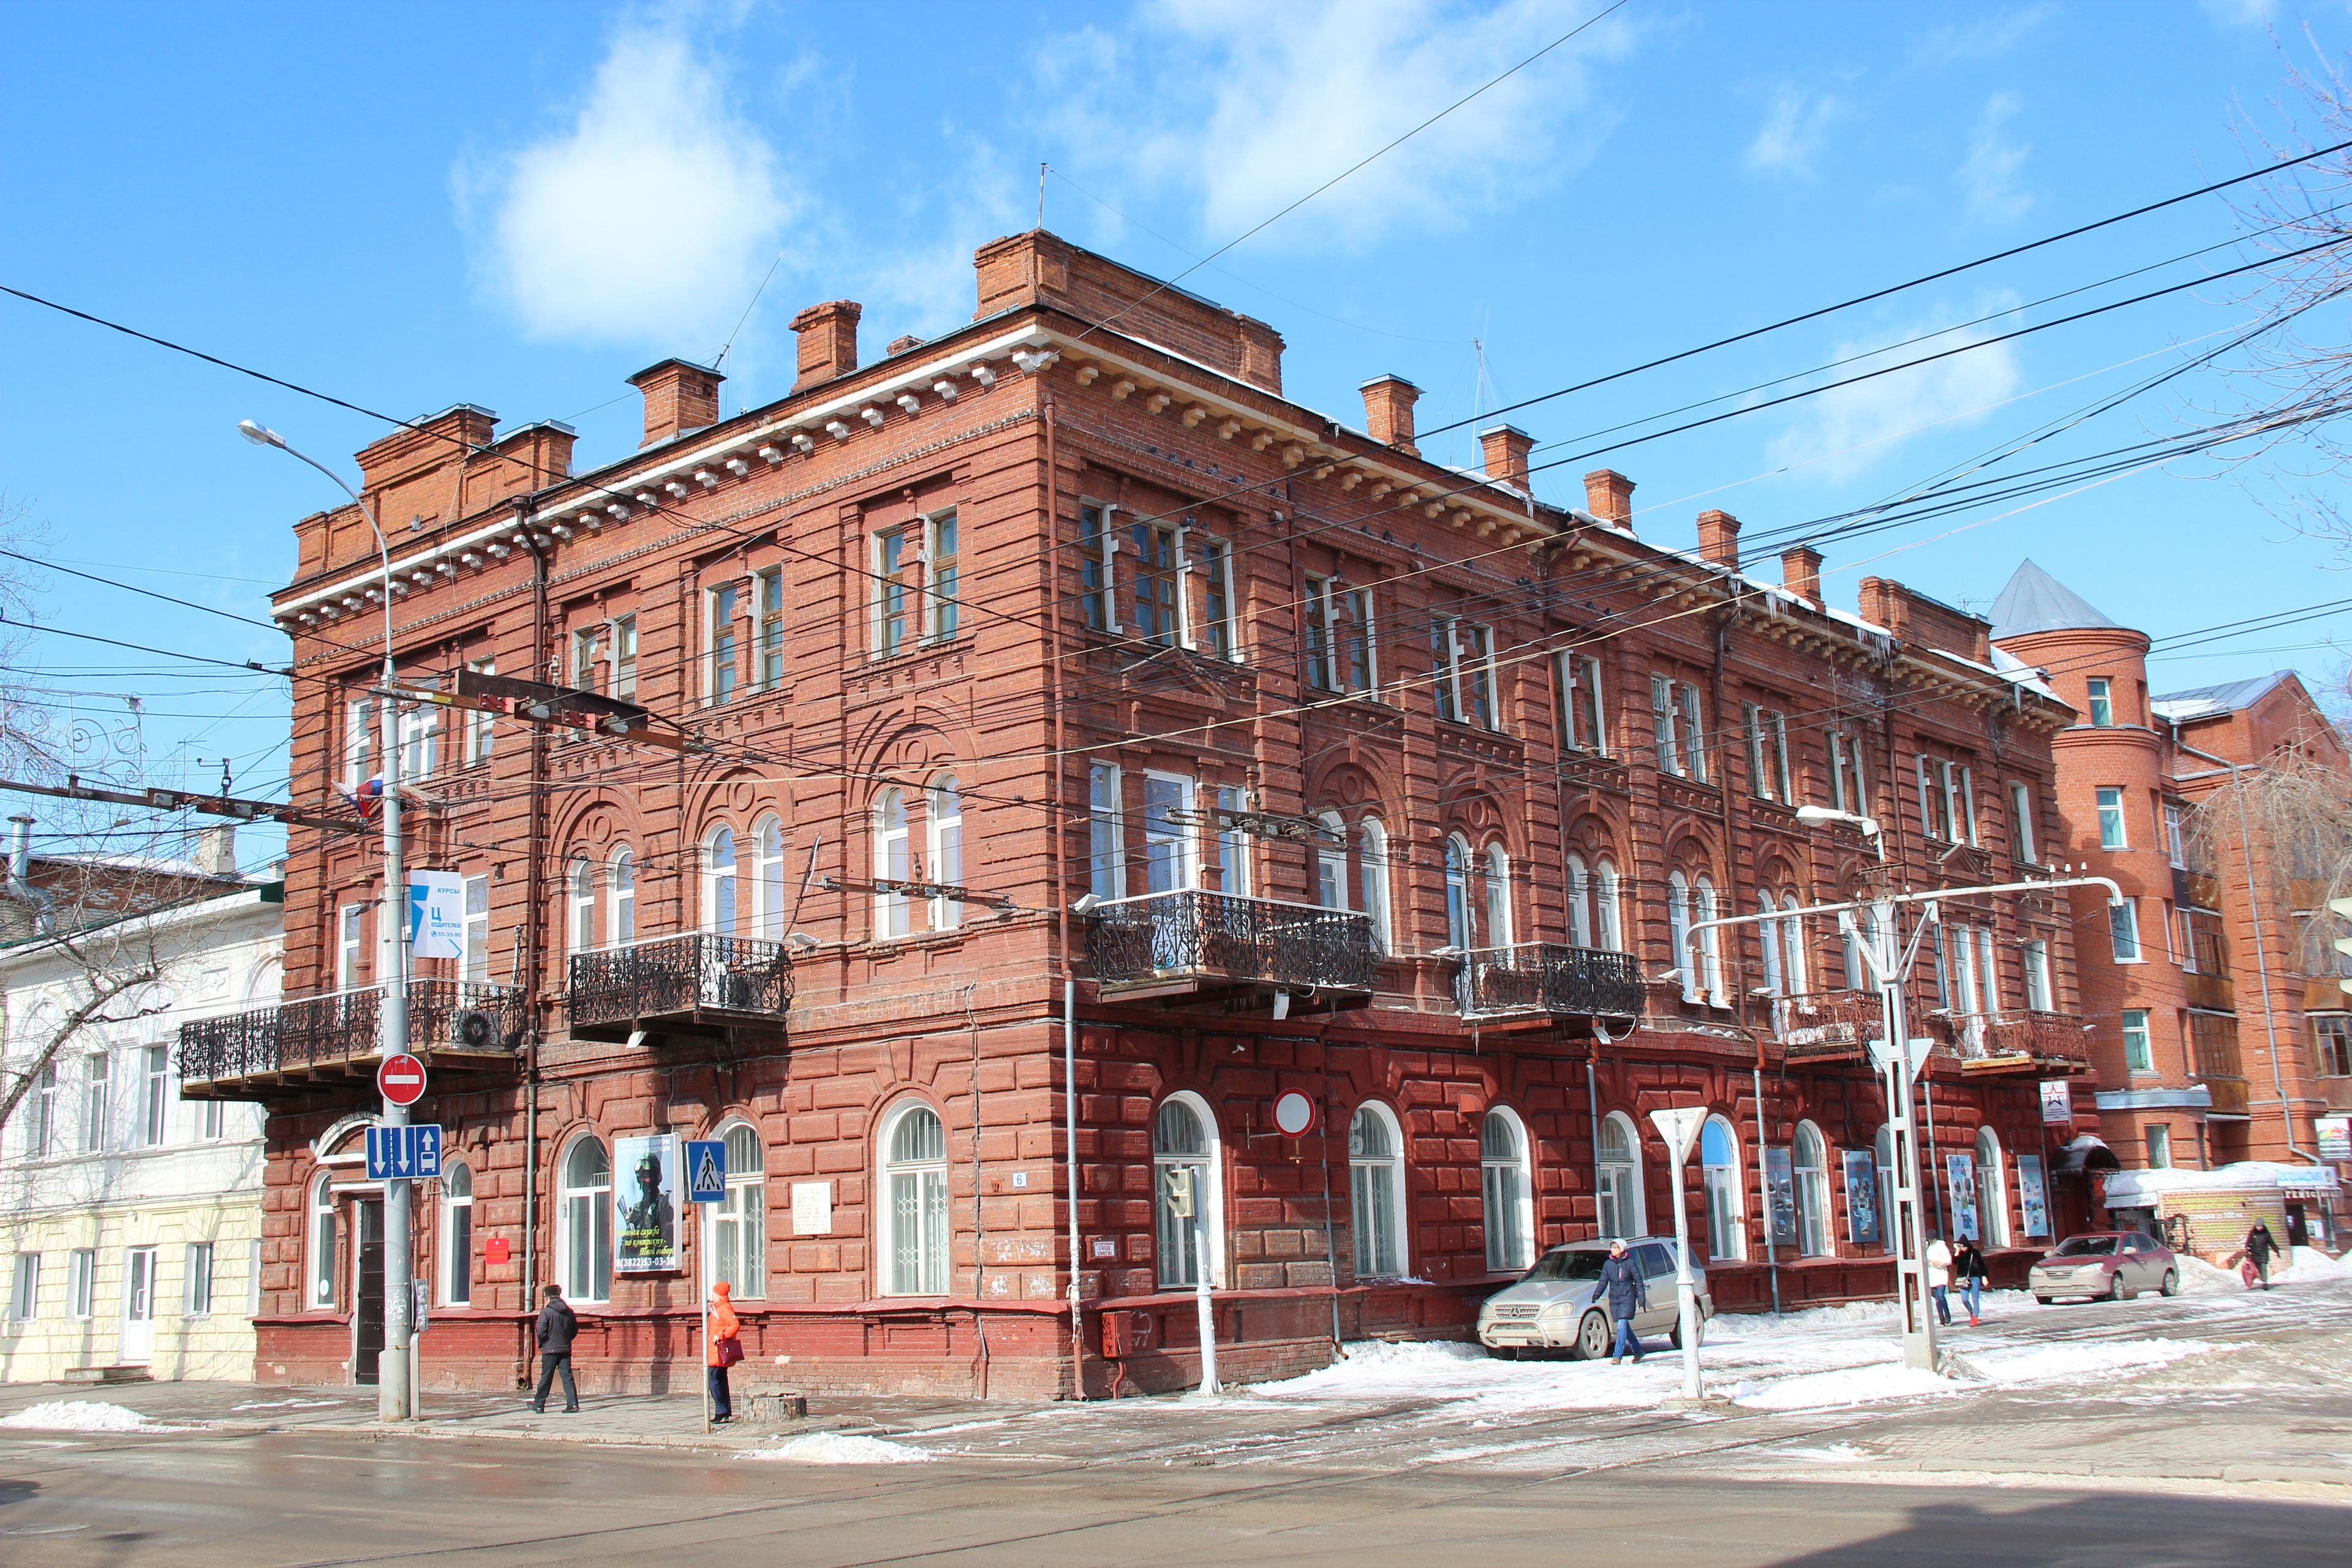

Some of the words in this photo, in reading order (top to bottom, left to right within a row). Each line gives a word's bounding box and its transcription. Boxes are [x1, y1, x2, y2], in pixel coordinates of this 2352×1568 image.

[431, 907, 442, 921] Ц
[1017, 1174, 1022, 1185] 6
[640, 1226, 660, 1238] служба
[633, 1238, 663, 1248] контракту
[639, 1246, 655, 1256] Твой
[616, 1257, 674, 1268] 8(3822)53-03-38
